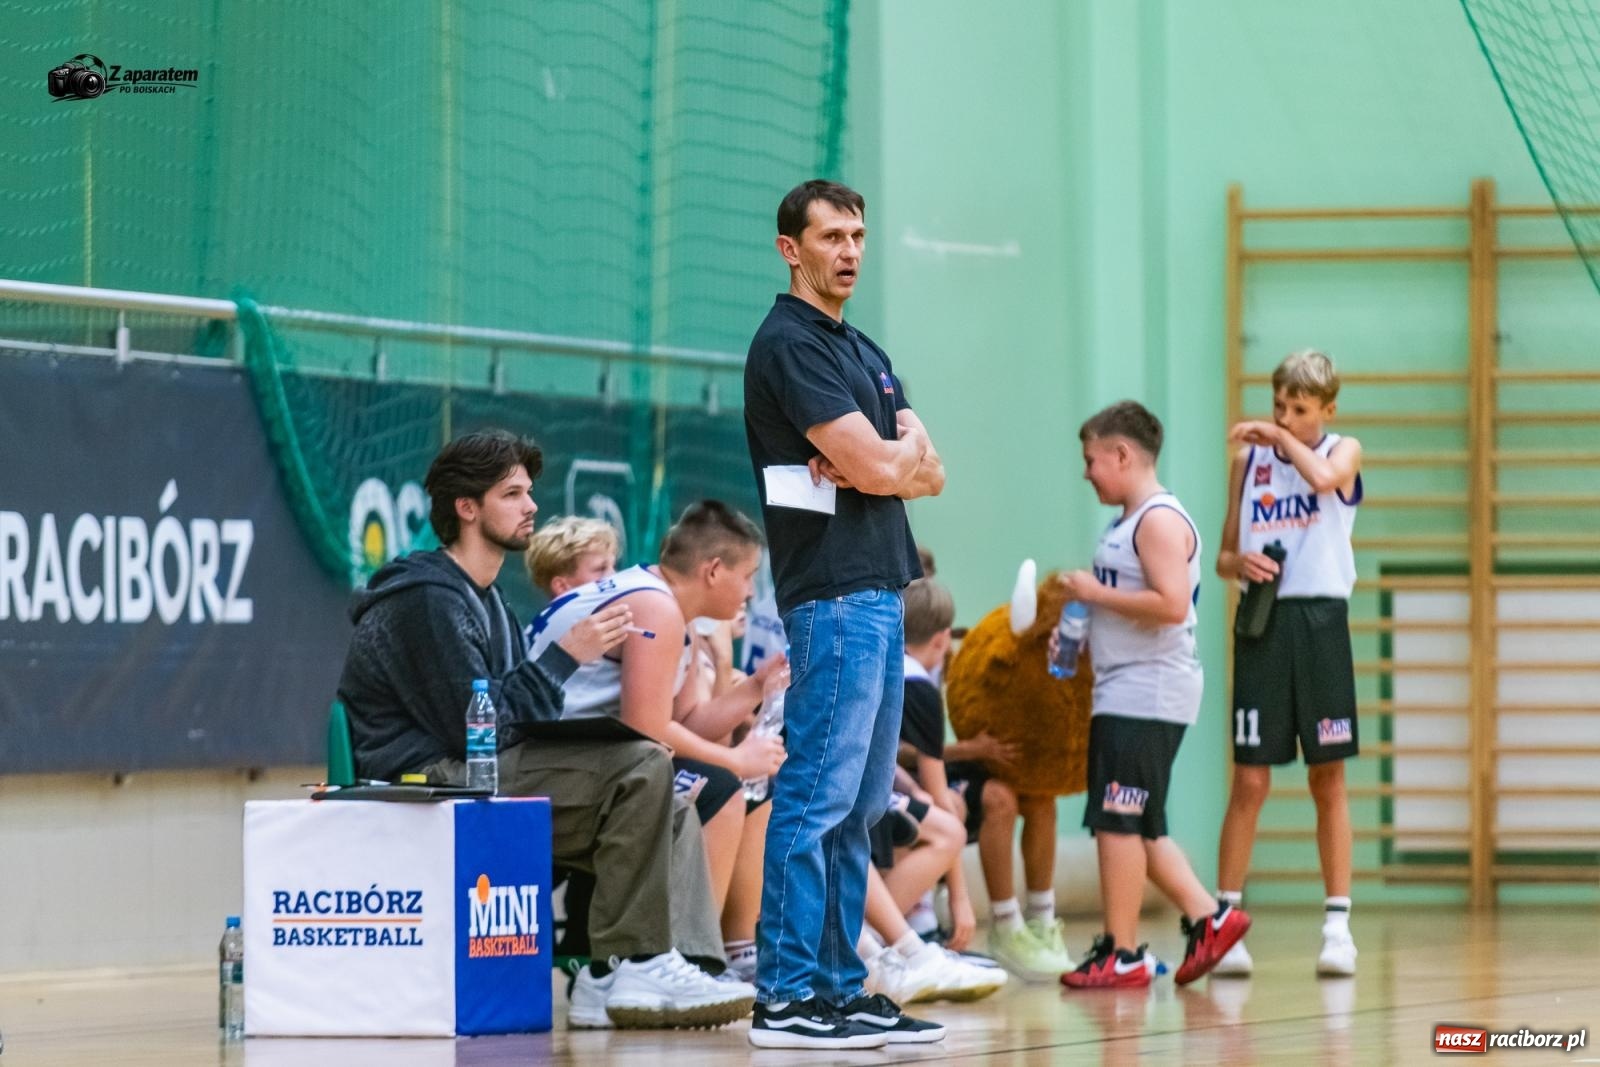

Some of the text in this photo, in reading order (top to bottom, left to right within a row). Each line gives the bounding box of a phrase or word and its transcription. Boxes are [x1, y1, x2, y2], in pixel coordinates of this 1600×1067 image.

[0, 478, 254, 625] RACIBÓRZ
[1235, 708, 1261, 746] 11
[273, 883, 423, 914] RACIBÓRZ
[468, 885, 539, 937] MINI
[273, 928, 423, 946] BASKETBALL
[468, 934, 539, 959] BASKETBALL
